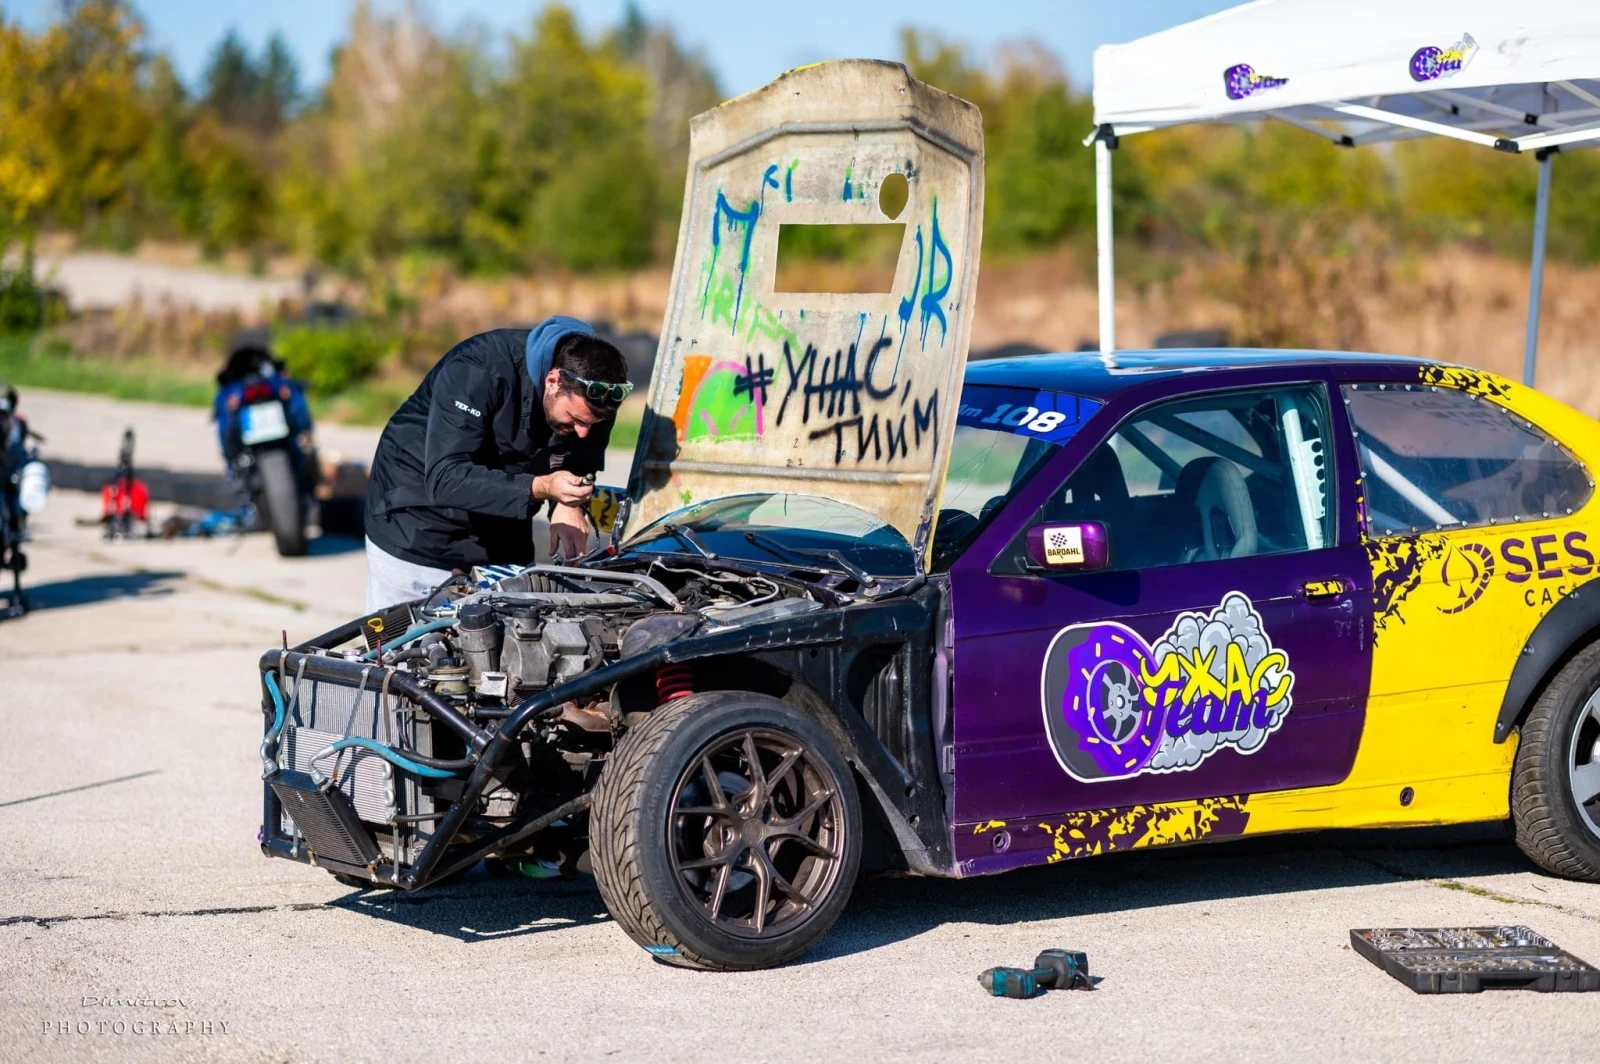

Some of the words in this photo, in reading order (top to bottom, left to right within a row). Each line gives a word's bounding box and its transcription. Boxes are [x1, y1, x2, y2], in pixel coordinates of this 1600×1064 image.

[981, 403, 1067, 432] 108
[1047, 547, 1081, 559] BARDAHL
[1500, 531, 1600, 583] SES
[1139, 676, 1275, 738] Team
